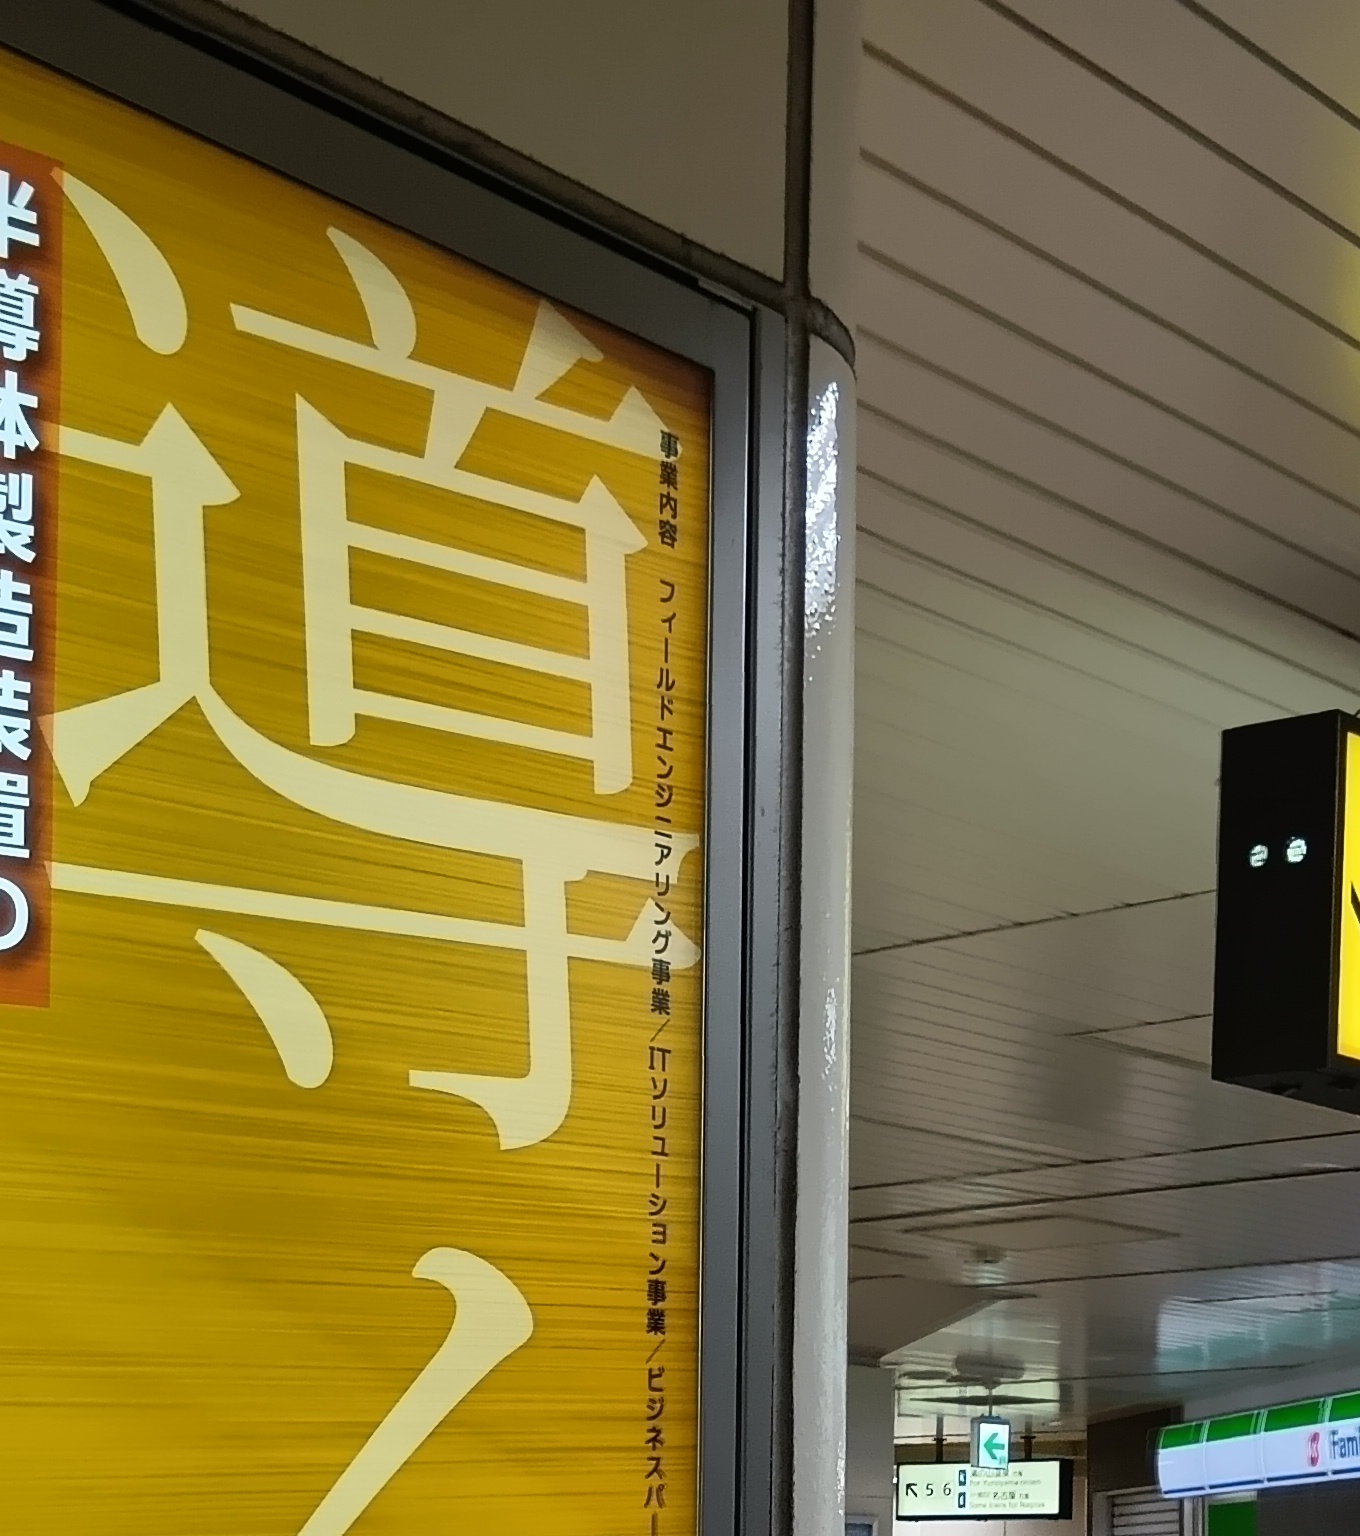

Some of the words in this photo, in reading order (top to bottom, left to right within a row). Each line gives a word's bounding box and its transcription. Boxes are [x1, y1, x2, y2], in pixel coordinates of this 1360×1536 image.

[657, 428, 679, 550] 事業内容
[925, 1483, 934, 1496] 5
[943, 1482, 952, 1496] 6
